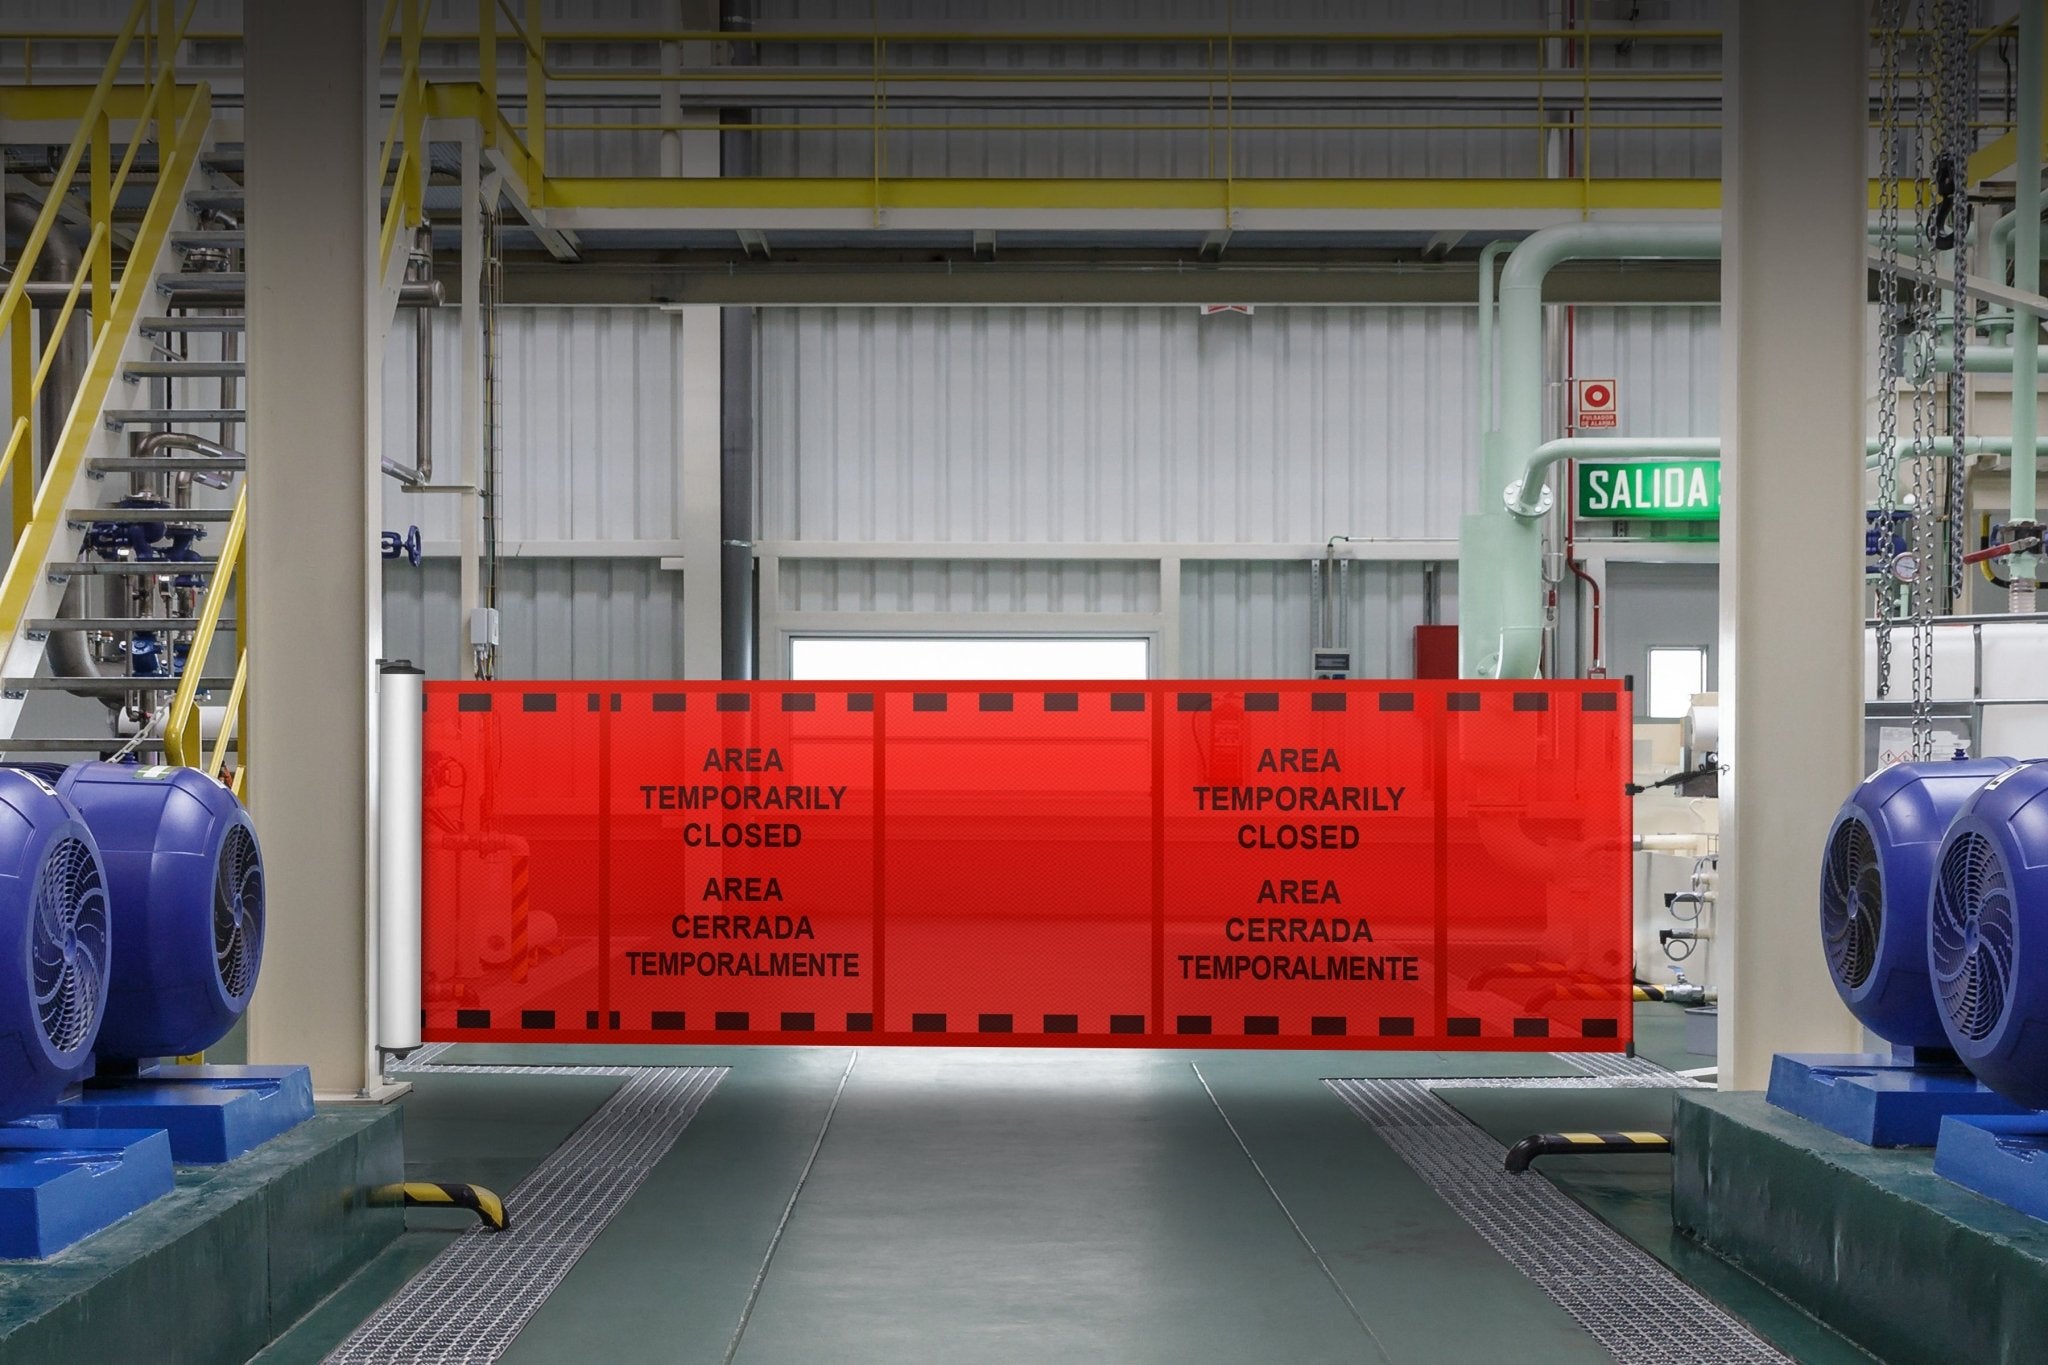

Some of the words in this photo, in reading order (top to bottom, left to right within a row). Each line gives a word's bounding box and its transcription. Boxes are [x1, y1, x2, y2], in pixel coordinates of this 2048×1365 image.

[1589, 467, 1708, 509] SALIDA
[703, 748, 784, 772] AREA
[1257, 748, 1341, 772] AREA
[640, 785, 846, 810] TEMPORARILY
[1193, 786, 1405, 811] TEMPORARILY
[684, 823, 801, 848] CLOSED
[1238, 824, 1359, 849] CLOSED
[703, 877, 783, 901] AREA
[1257, 880, 1341, 904] AREA
[672, 914, 814, 939] CERRADA
[1226, 917, 1373, 942] CERRADA
[626, 952, 859, 976] TEMPORALMENTE
[1178, 956, 1418, 980] TEMPORALMENTE
